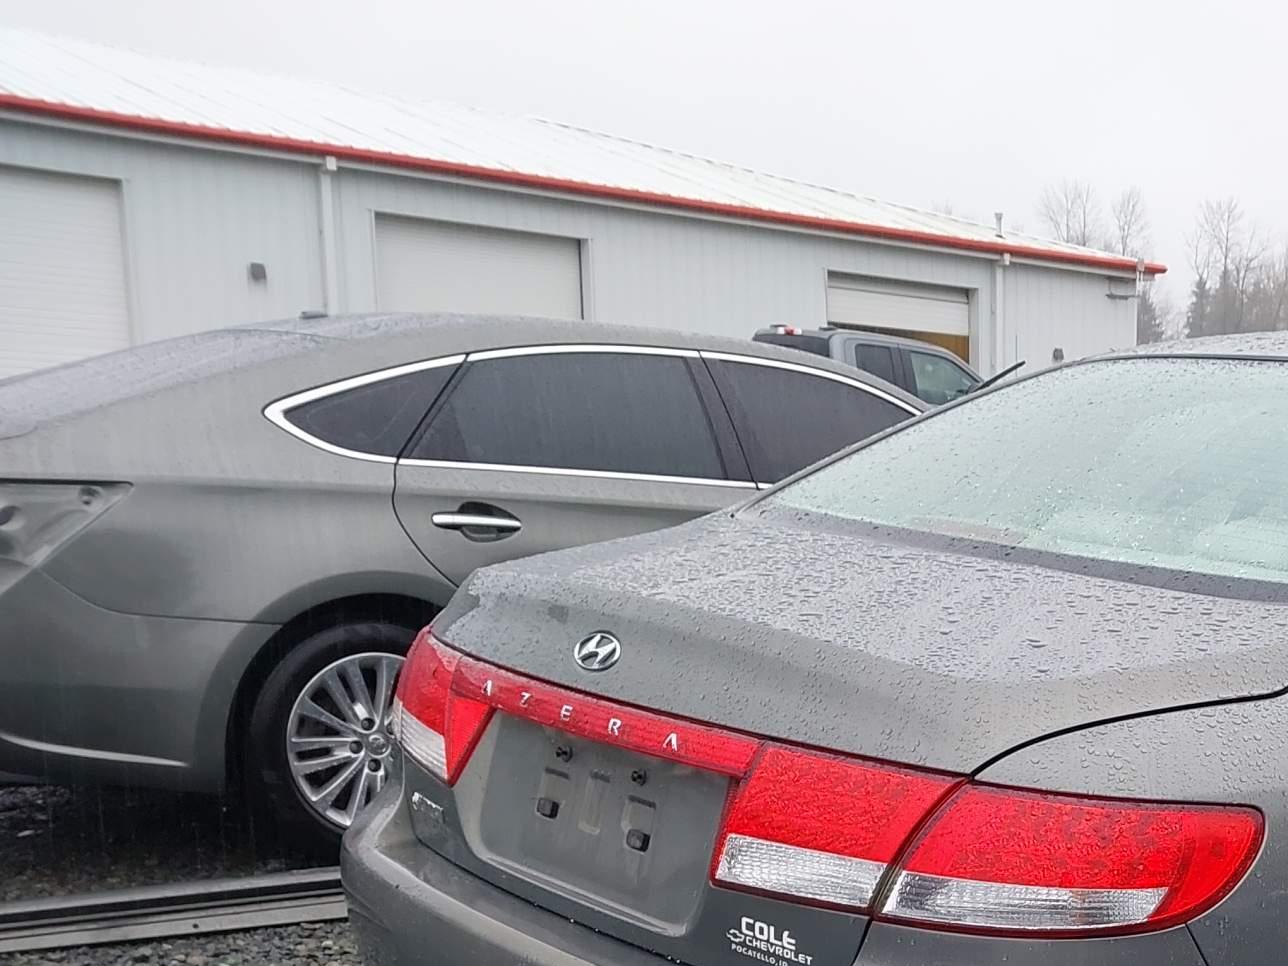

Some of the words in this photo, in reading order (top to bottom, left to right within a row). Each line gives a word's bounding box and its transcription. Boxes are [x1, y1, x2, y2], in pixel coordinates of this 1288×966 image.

[481, 679, 678, 752] AZERA
[741, 916, 796, 951] COLE
[745, 936, 813, 965] CHEVROLET
